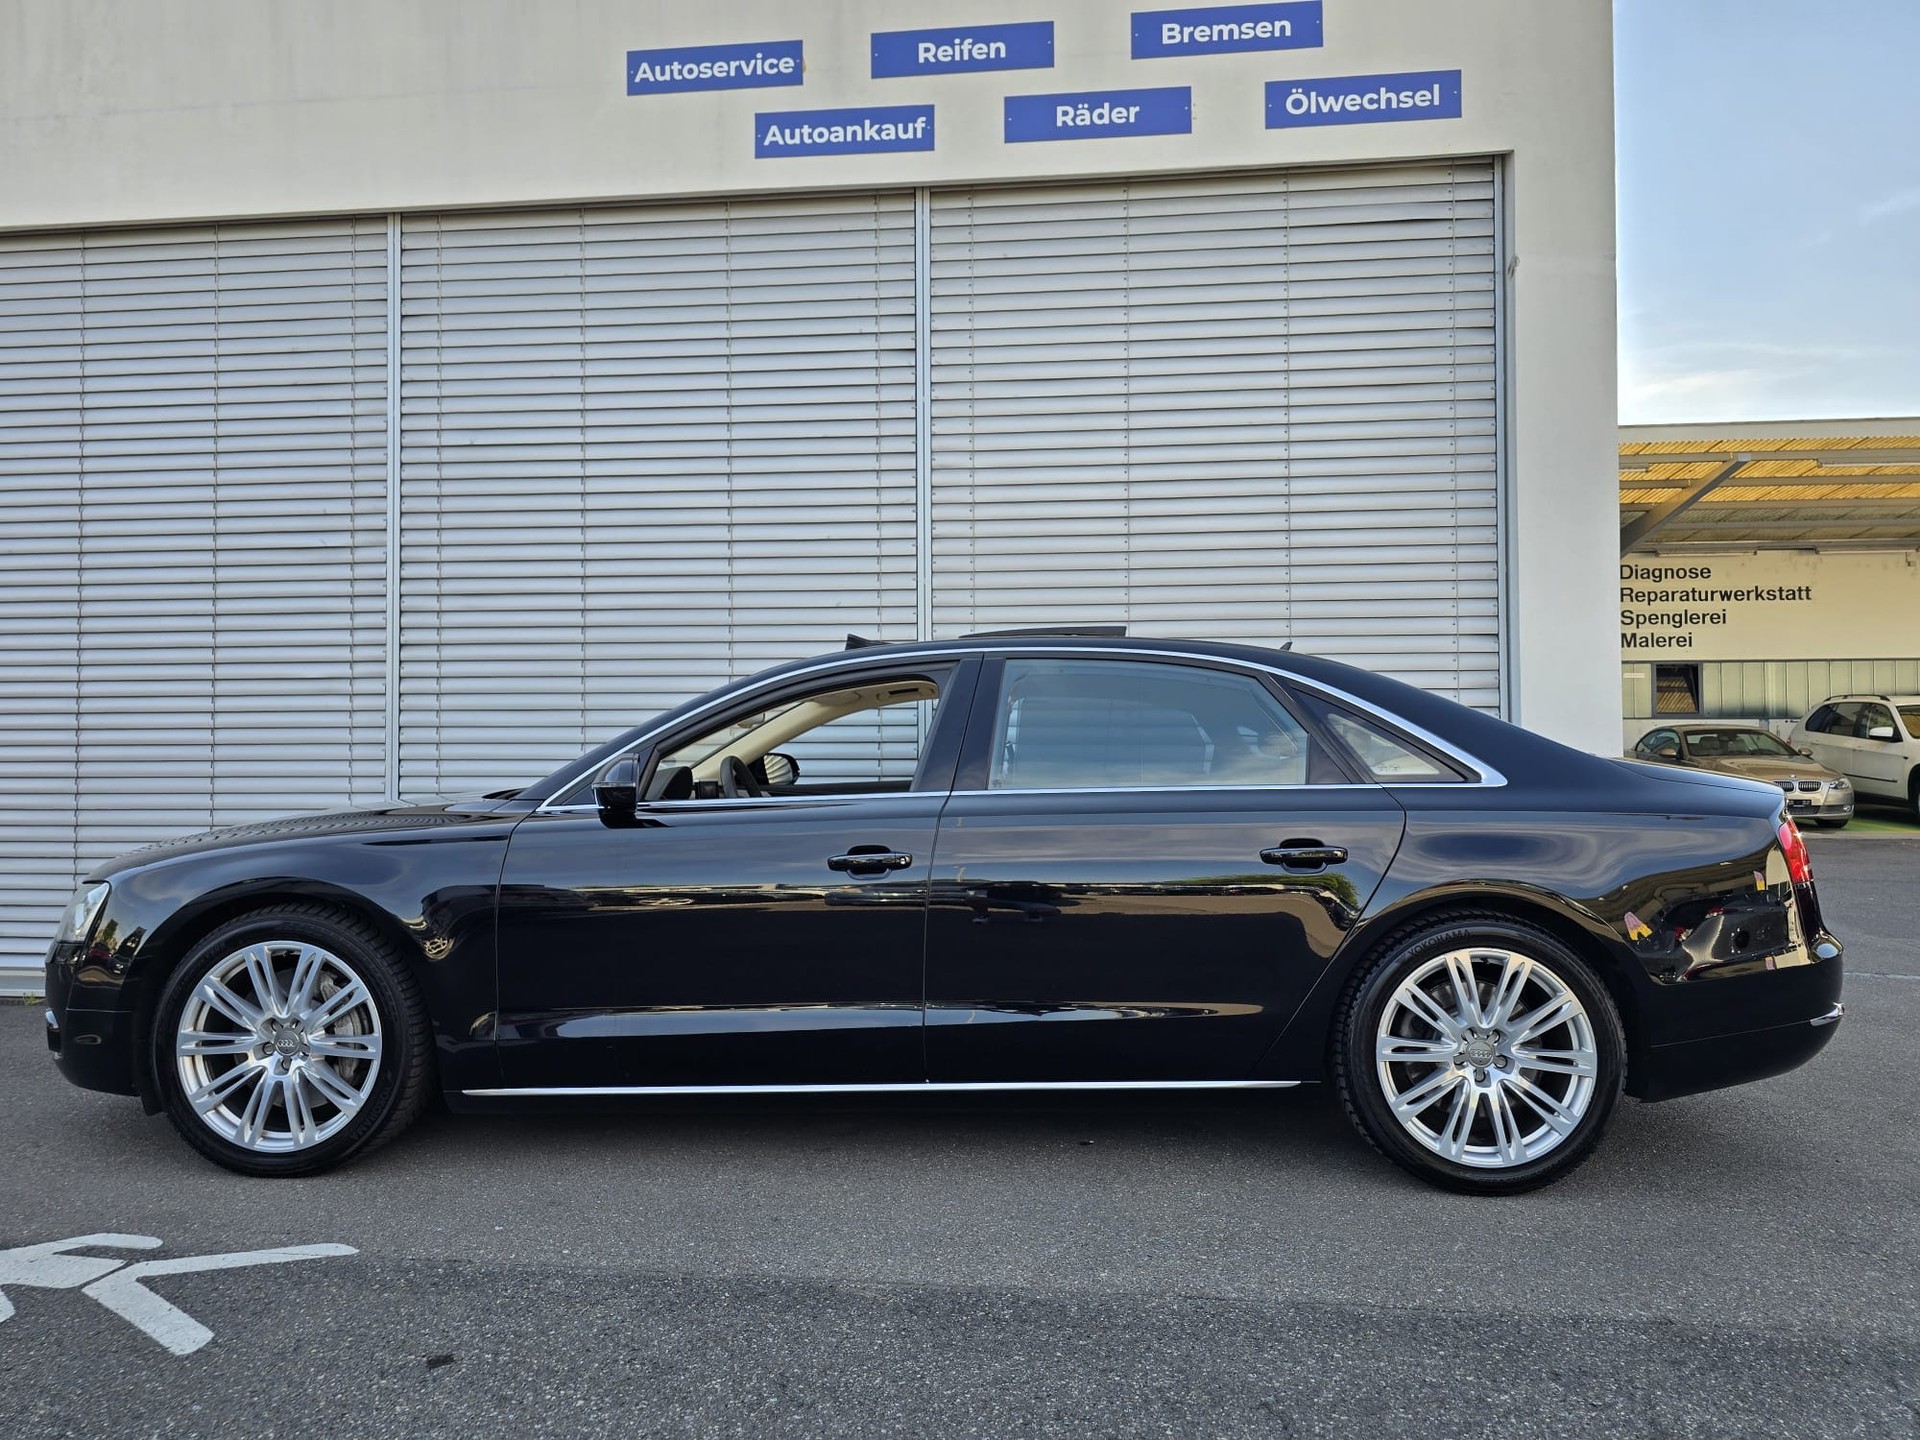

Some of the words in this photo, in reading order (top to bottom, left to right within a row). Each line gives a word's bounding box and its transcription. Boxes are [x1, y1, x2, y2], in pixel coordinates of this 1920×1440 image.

[1162, 20, 1292, 45] Bremsen
[918, 38, 1006, 64] Reifen
[634, 52, 795, 83] Autoservice
[1285, 83, 1440, 115] Ölwechsel
[1056, 102, 1140, 127] Räder
[763, 116, 927, 146] Autoankauf
[1620, 564, 1712, 583] Diagnose
[1620, 586, 1812, 606] Reparaturwerkstatt
[1620, 609, 1727, 629] Spenglerei
[1620, 632, 1693, 648] Malerei
[1407, 929, 1472, 956] YOKOHAMA
